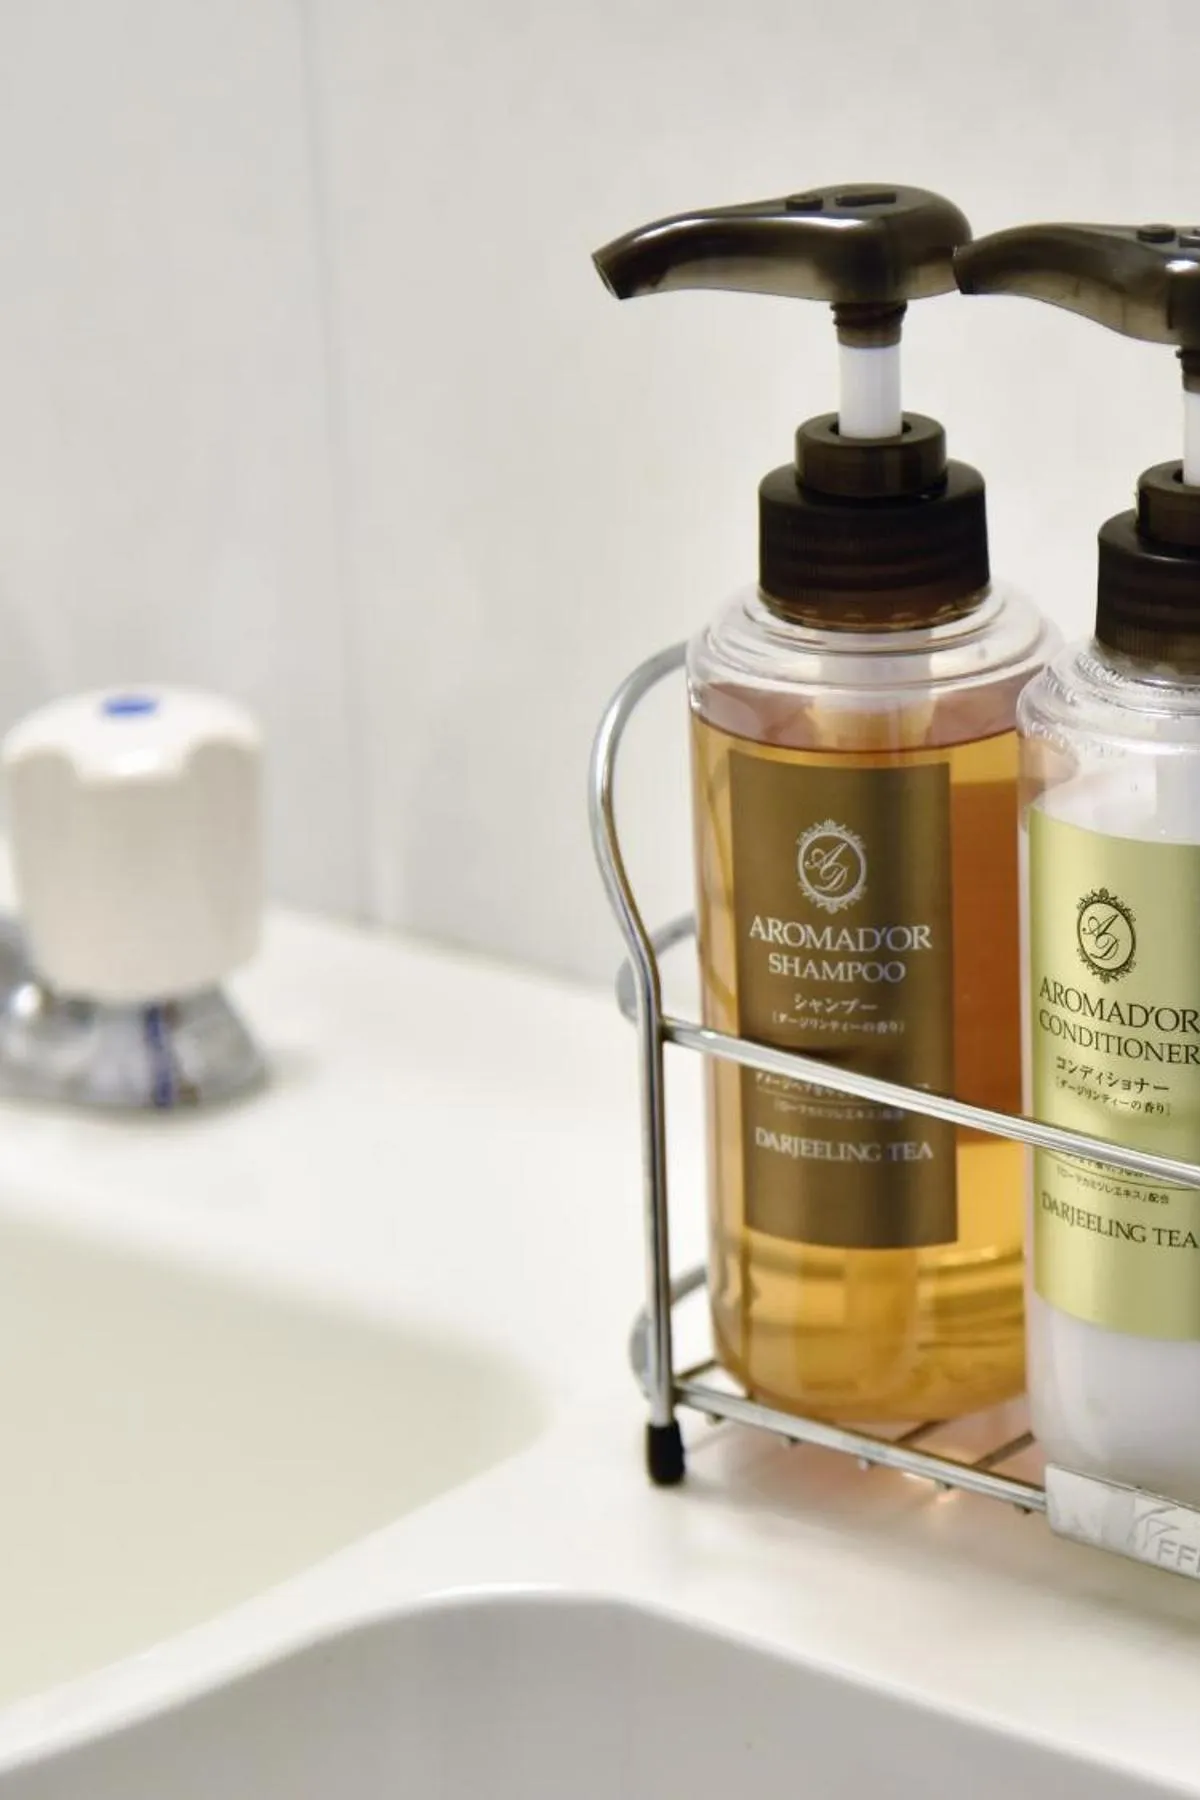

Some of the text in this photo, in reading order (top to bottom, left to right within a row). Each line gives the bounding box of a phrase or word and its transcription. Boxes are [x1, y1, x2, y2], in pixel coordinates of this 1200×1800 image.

[749, 914, 933, 953] AROMAD'OR
[767, 951, 906, 983] SHAMPOO
[793, 993, 878, 1014] シャンプー
[1039, 976, 1200, 1034] AROMAD'OR
[1039, 1009, 1200, 1065] CONDITIONER
[1056, 1056, 1170, 1094] コンディショナー
[755, 1126, 934, 1162] DARJEELING TEA
[1041, 1190, 1200, 1249] DARJEELING TEA
